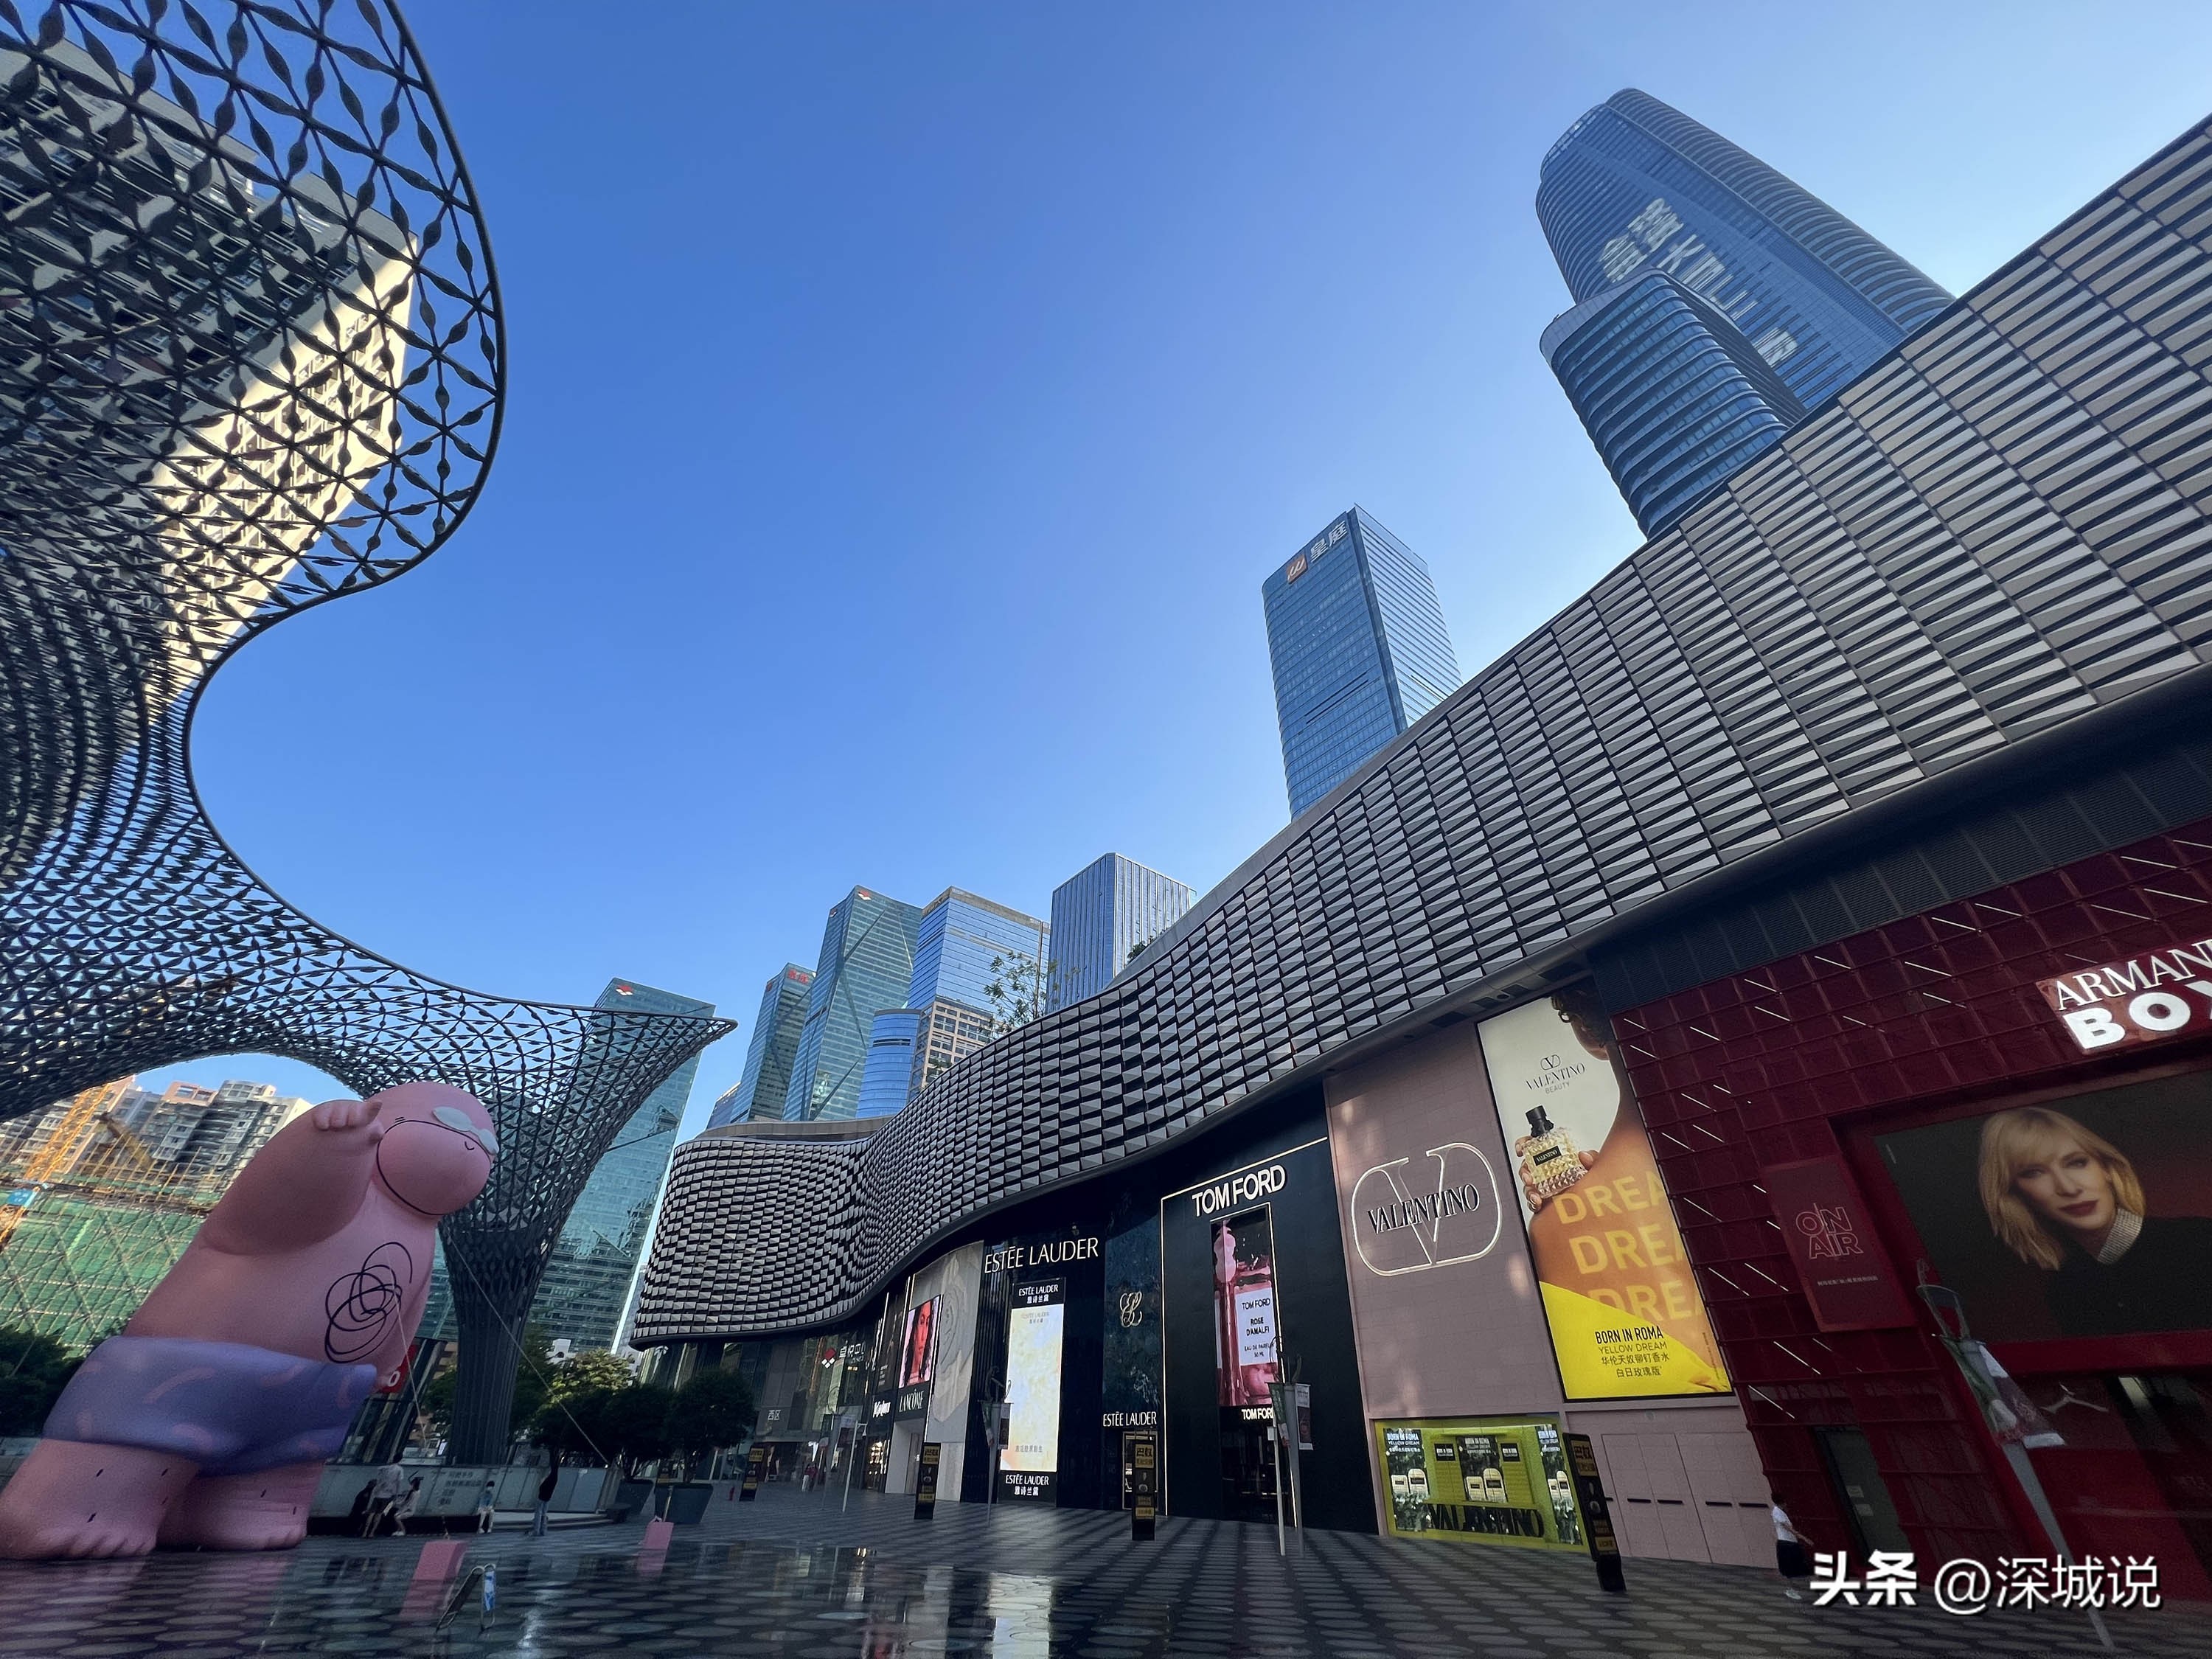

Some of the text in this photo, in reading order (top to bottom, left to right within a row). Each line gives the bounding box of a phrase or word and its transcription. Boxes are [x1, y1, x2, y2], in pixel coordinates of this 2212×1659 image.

[2056, 938, 2212, 1011] ARMAN
[1526, 1062, 1585, 1091] VALENTINO
[1545, 1081, 1571, 1094] BEAUTY
[1192, 1164, 1286, 1217] TOM FORD
[1367, 1182, 1480, 1234] VALENTINO
[1795, 1206, 1853, 1236] ON
[1029, 1237, 1099, 1266] LAUDER
[1809, 1232, 1865, 1259] AIR
[1036, 1284, 1059, 1295] LAUDER
[1242, 1297, 1270, 1310] TOM FORD
[1251, 1316, 1264, 1326] ROSE
[1595, 1325, 1664, 1345] BORN IN ROMA
[1599, 1341, 1668, 1355] YELLOW DREAM
[767, 1409, 782, 1421] 西区
[1126, 1411, 1157, 1426] LAUDER
[1241, 1408, 1257, 1420] TOM
[1024, 1475, 1049, 1486] LAUDER
